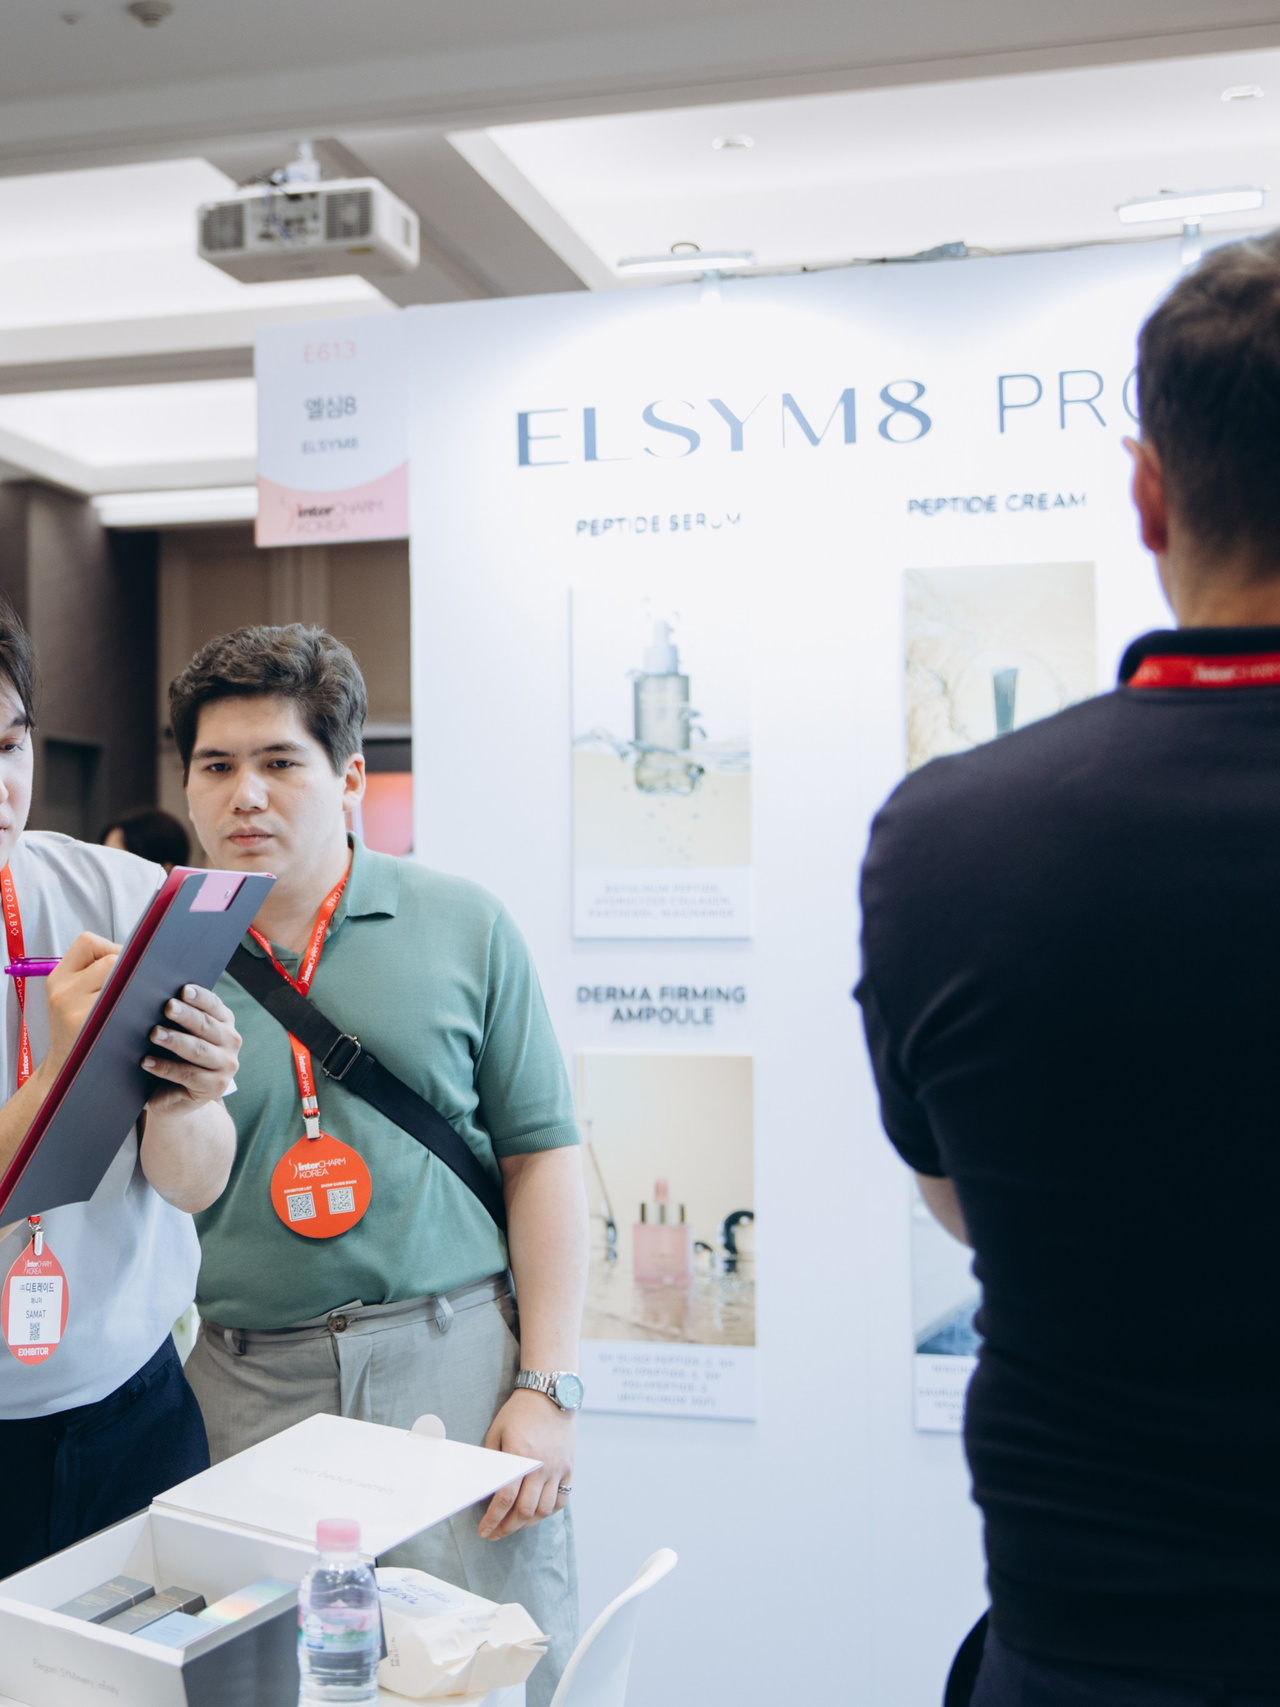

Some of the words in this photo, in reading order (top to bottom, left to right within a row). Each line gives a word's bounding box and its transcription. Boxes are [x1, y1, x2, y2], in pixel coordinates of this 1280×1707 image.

[303, 341, 356, 364] E613
[517, 379, 933, 468] ELSYM8
[302, 437, 359, 455] ELSYM8
[908, 494, 998, 516] PEPTIDE
[1006, 491, 1087, 513] CREAM
[576, 517, 661, 537] PEPTIDE
[3, 878, 18, 928] USOLAB
[577, 986, 652, 1003] DERMA
[659, 986, 746, 1004] FIRMING
[611, 1006, 714, 1025] AMPOULE
[298, 1157, 347, 1171] interCHARM
[299, 1168, 329, 1179] KOREA
[26, 1309, 46, 1319] SAMAT
[18, 1347, 49, 1357] EXHIBITOR
